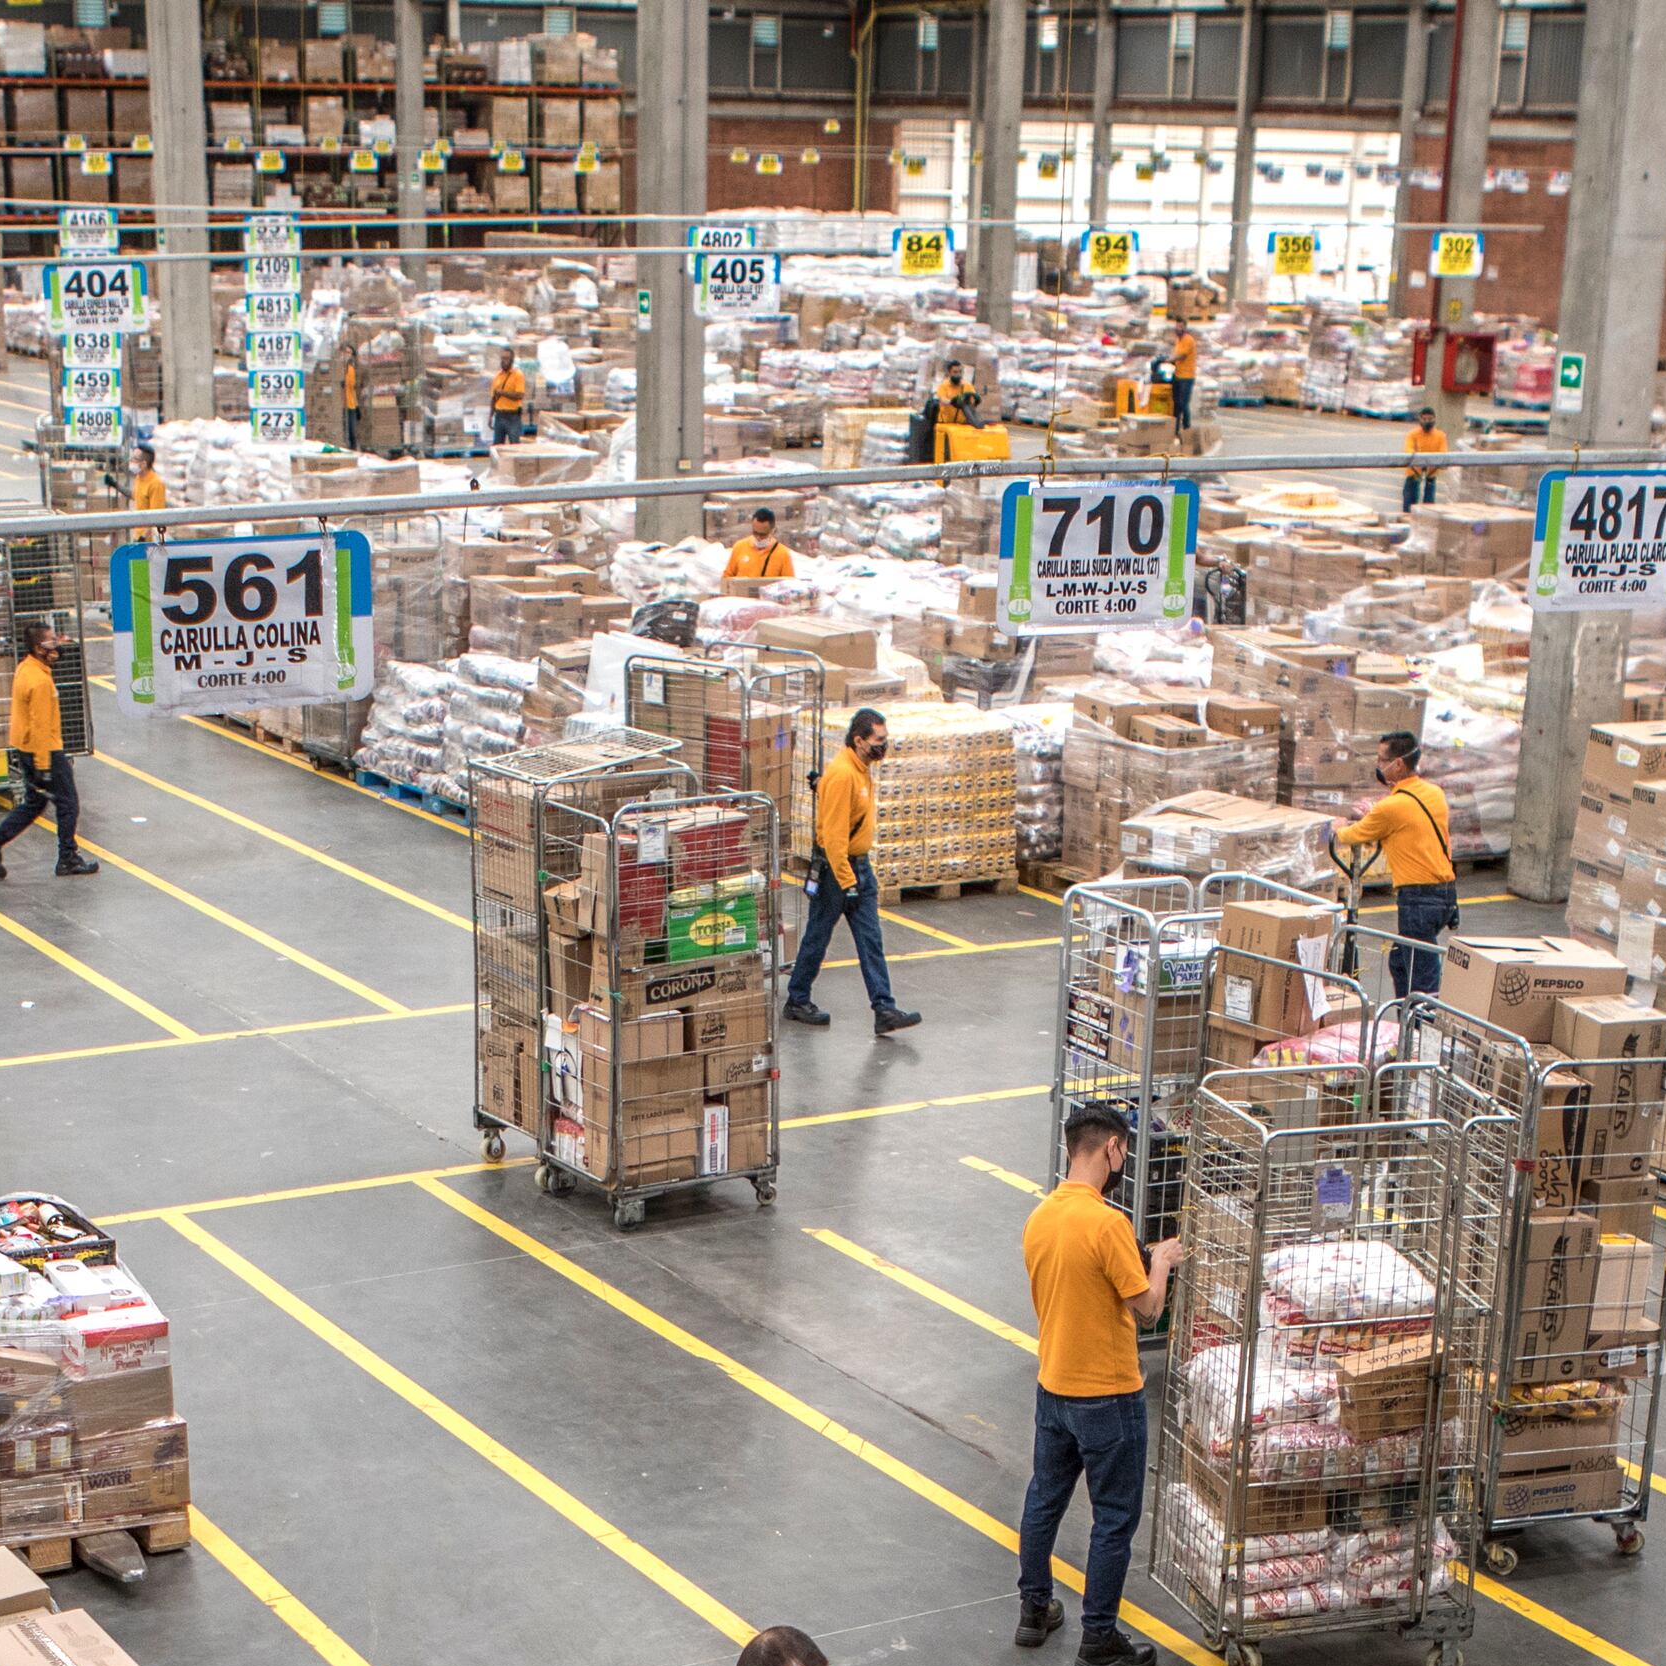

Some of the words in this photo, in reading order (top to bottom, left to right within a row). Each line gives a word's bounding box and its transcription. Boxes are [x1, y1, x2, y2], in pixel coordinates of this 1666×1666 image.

[701, 231, 743, 247] 4802
[906, 236, 942, 251] 84
[1095, 235, 1127, 253] 94
[1280, 236, 1312, 253] 356
[1444, 238, 1474, 253] 302
[255, 257, 290, 273] 4109
[711, 259, 764, 284] 405
[64, 270, 130, 298] 404
[257, 299, 292, 313] 4813
[73, 334, 110, 348] 638
[258, 336, 293, 351] 4187
[74, 373, 110, 387] 459
[260, 375, 295, 390] 530
[76, 411, 112, 426] 4808
[260, 412, 295, 427] 273
[1042, 495, 1164, 557] 710
[1565, 544, 1607, 564] CARULLA
[1609, 543, 1637, 562] PLAZA
[1037, 560, 1069, 578] CARULLA
[1071, 559, 1091, 577] BELLA
[1092, 558, 1113, 576] SUIZA
[1572, 564, 1657, 578] M-J-S
[161, 550, 324, 626] 561
[1046, 581, 1147, 597] L-M-W-J-V-S
[1578, 580, 1616, 593] CORTE
[1620, 580, 1647, 592] 4:00
[1056, 599, 1100, 615] CORTE
[1104, 598, 1137, 613] 4:00
[161, 625, 248, 654] CARULLA
[253, 621, 321, 650] COLINA
[198, 673, 247, 689] CORTE
[252, 670, 286, 685] 4:00
[650, 973, 711, 999] CORONA
[1534, 979, 1584, 989] PEPSICO
[88, 1472, 133, 1490] WATER
[1533, 1484, 1577, 1497] PEPSICO
